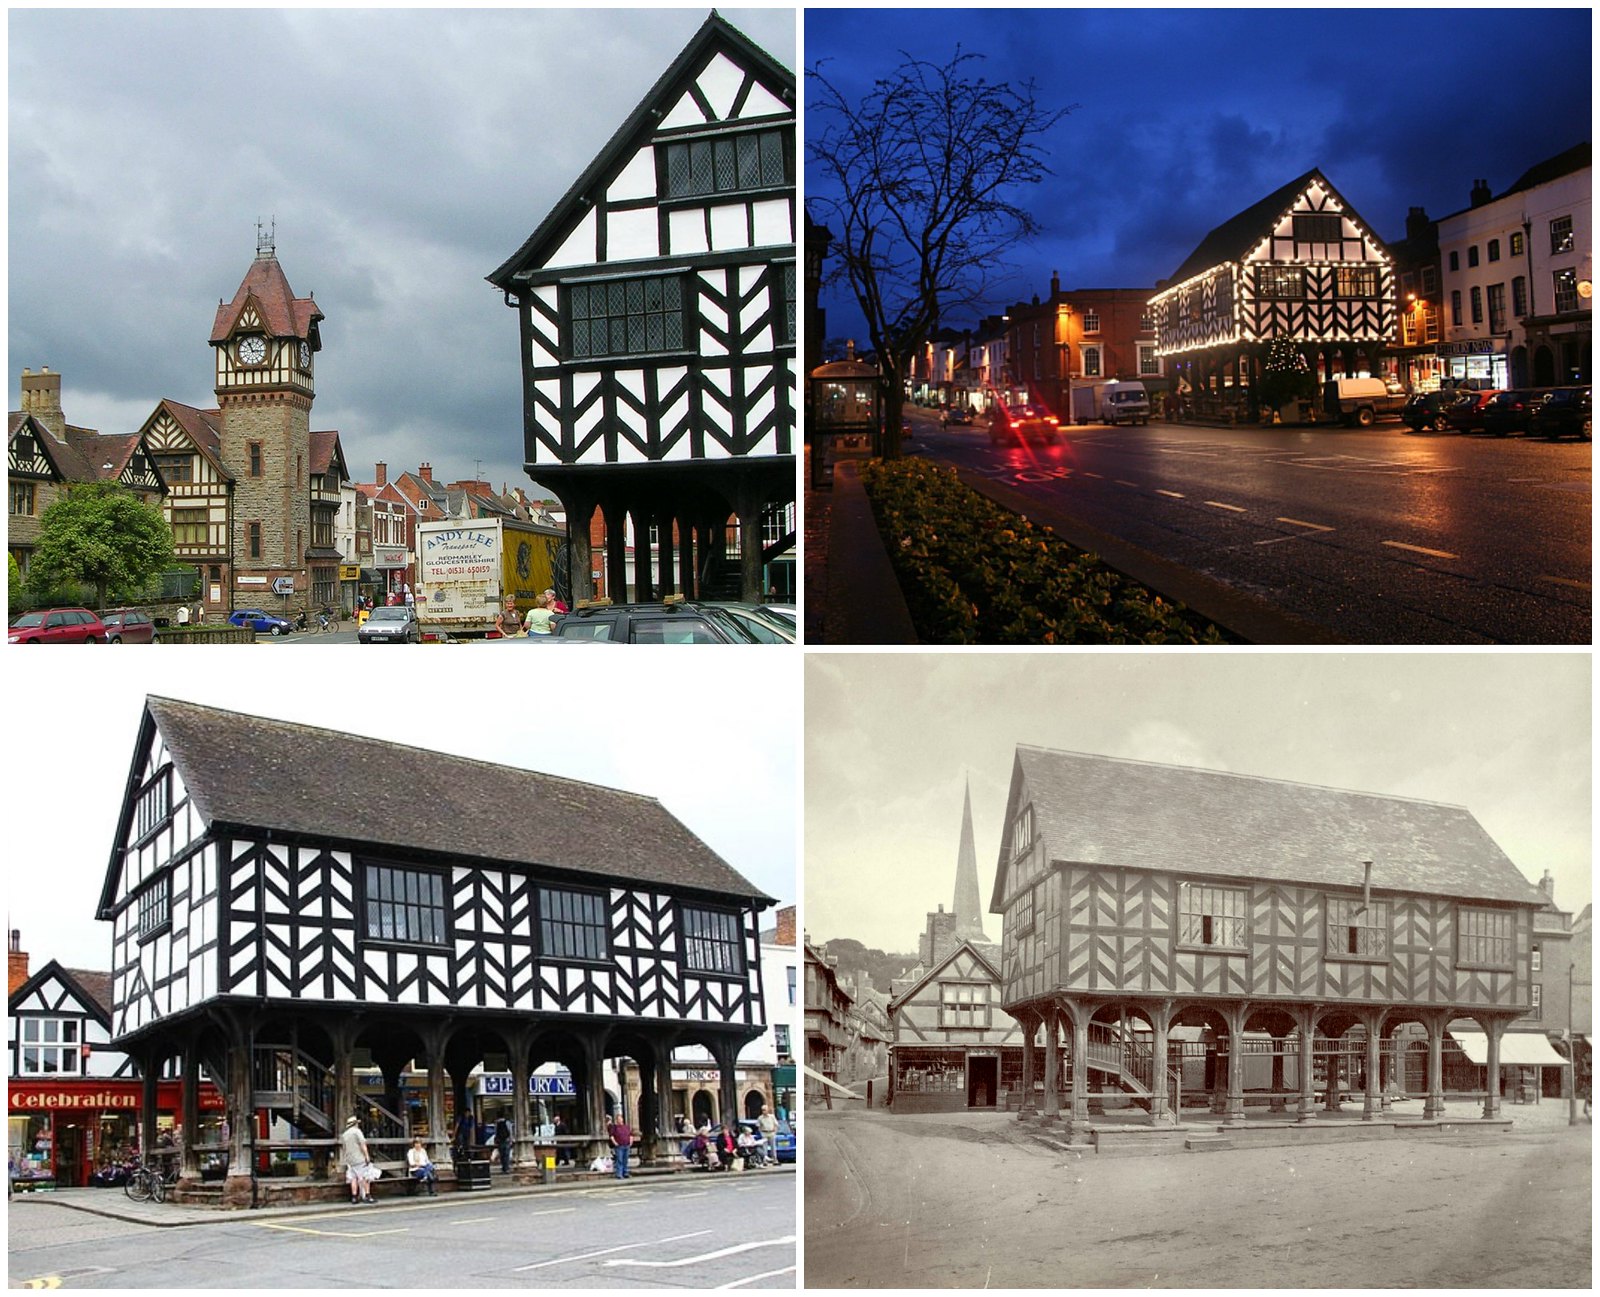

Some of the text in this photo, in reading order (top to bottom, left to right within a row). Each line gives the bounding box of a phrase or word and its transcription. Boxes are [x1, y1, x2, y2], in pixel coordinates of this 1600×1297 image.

[426, 530, 494, 550] ANDY LEE
[441, 542, 477, 550] Transport
[425, 558, 495, 566] GLOUCESTERSHIRE
[686, 1071, 704, 1080] HSBC
[500, 1077, 575, 1093] LEURY NE
[12, 1090, 136, 1108] Celebration
